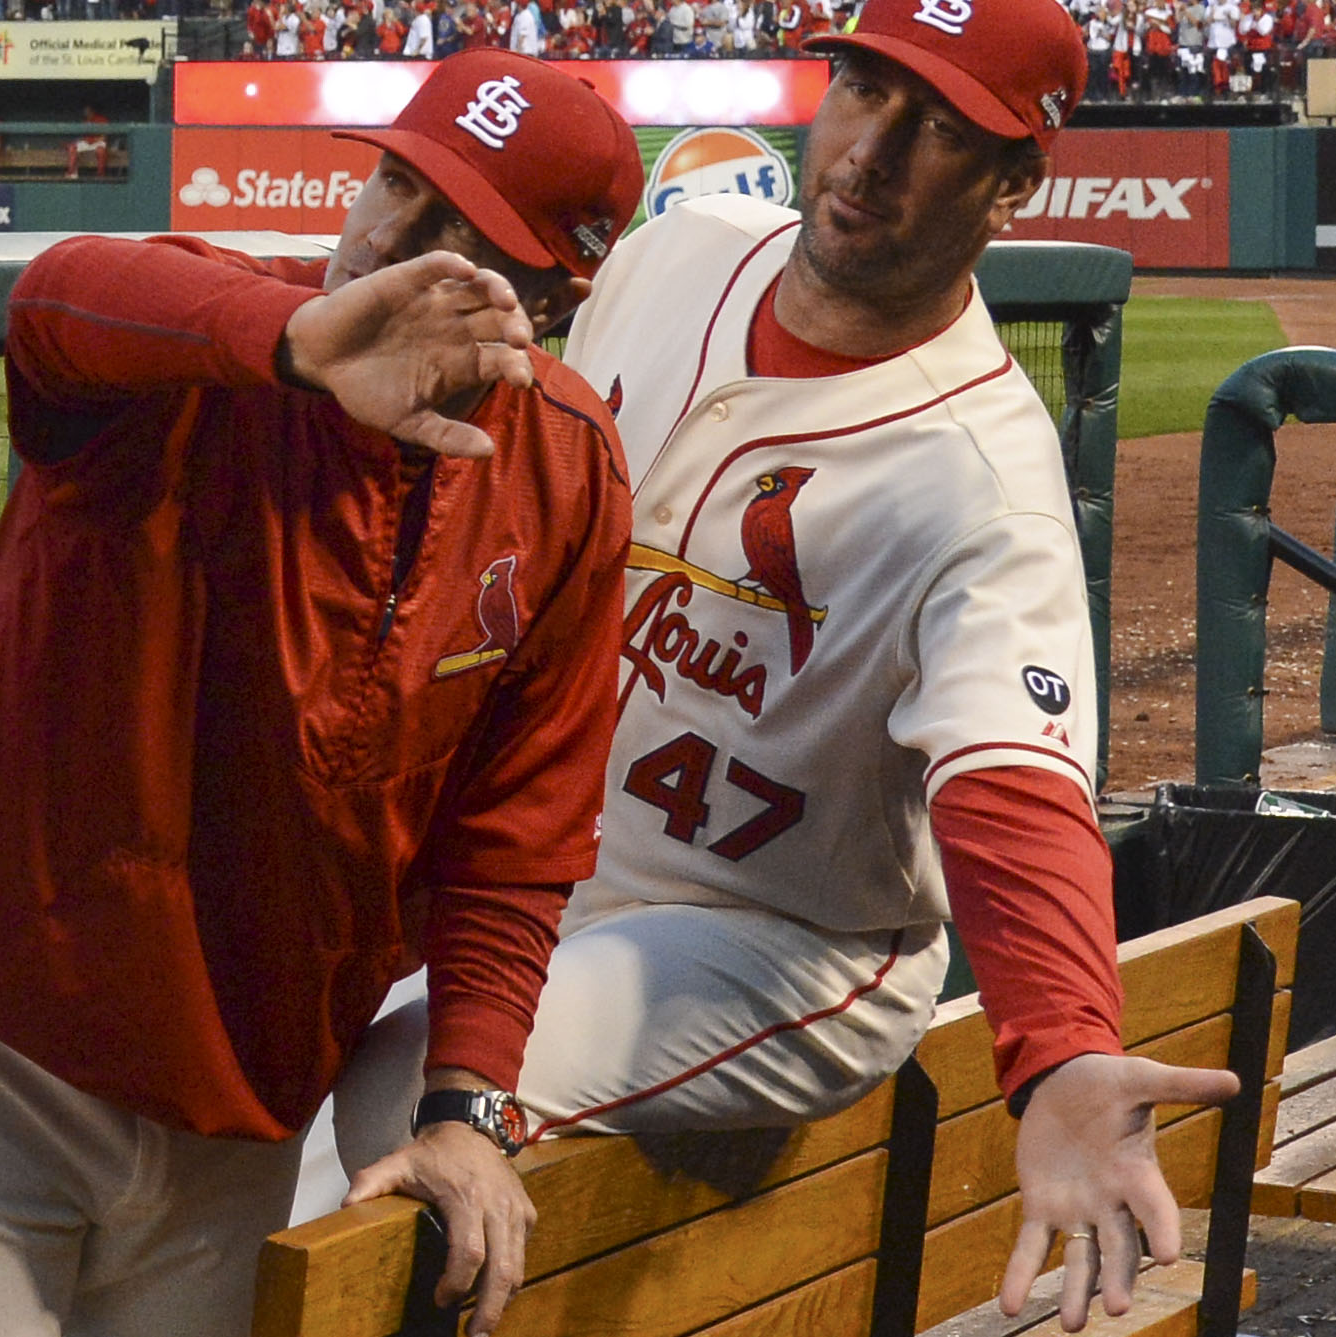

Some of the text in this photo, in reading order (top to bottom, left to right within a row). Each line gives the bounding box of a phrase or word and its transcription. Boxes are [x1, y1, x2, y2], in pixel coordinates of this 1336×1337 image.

[73, 38, 116, 51] Medical
[1026, 670, 1065, 704] OT
[622, 730, 807, 863] 47
